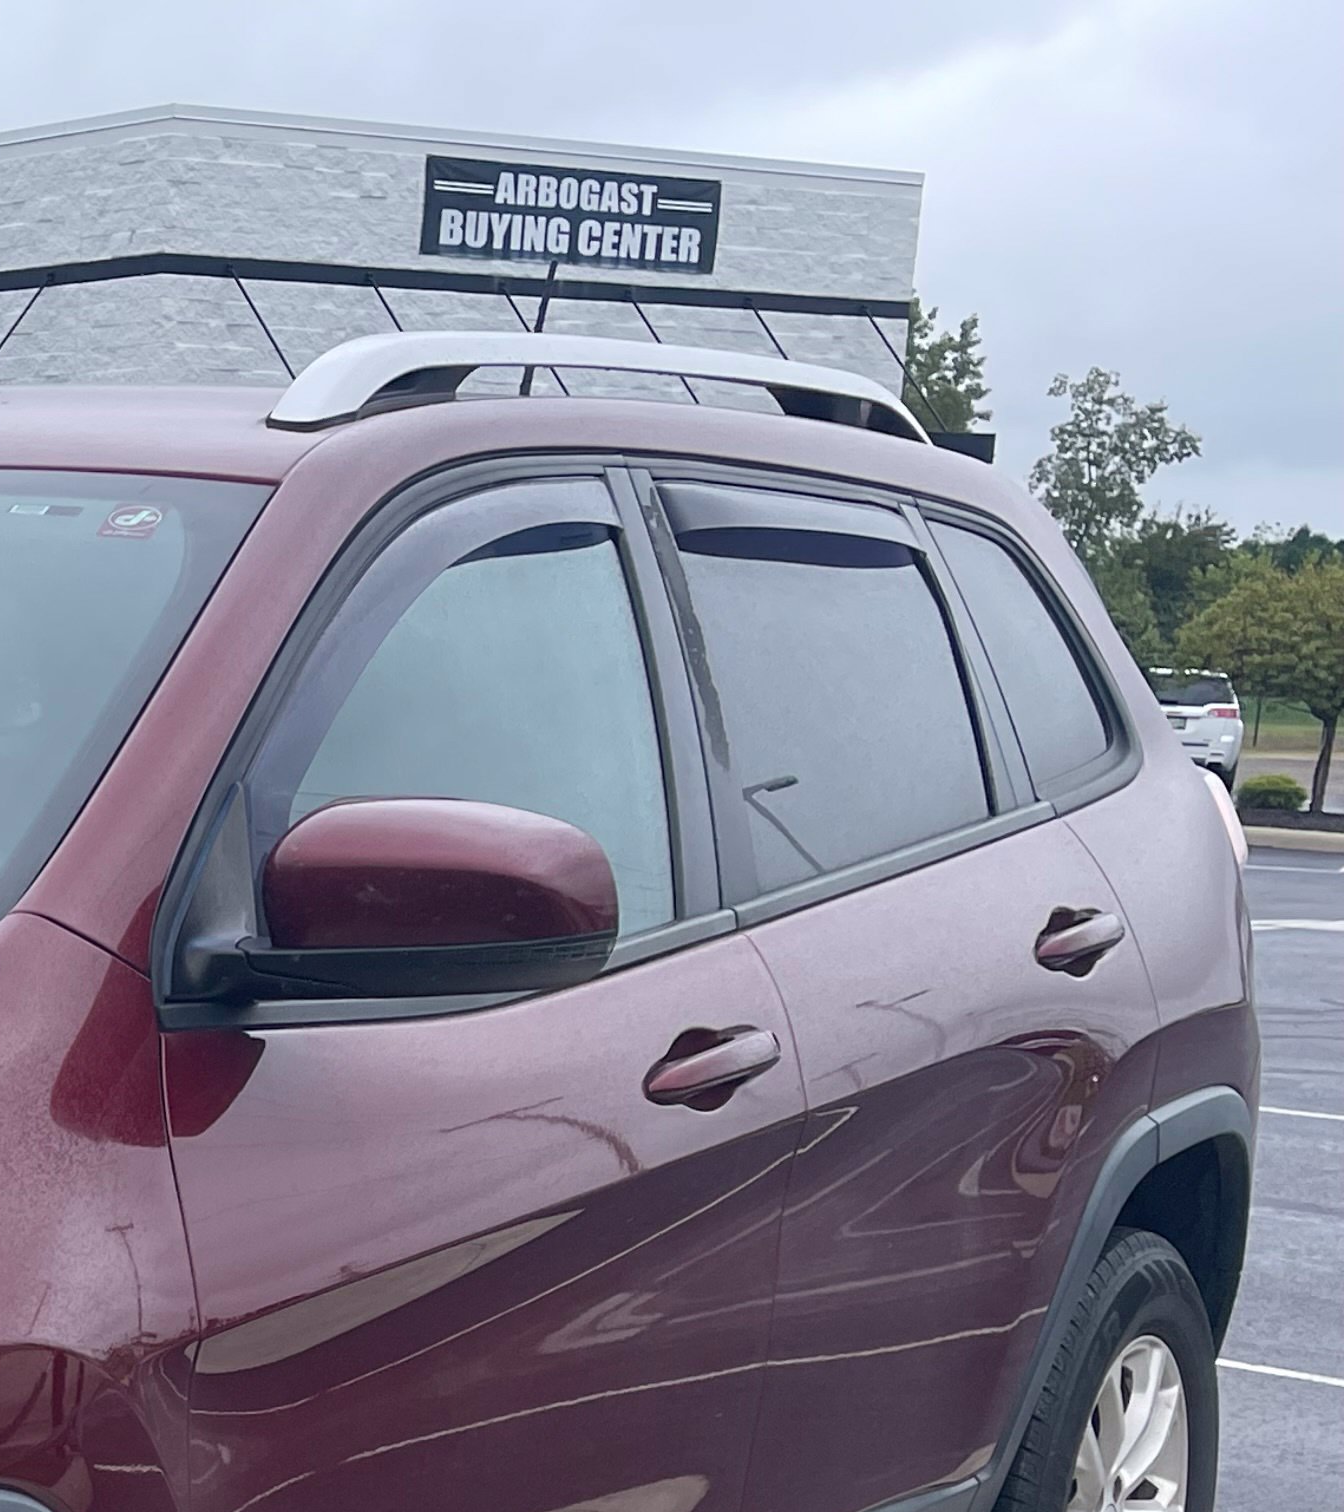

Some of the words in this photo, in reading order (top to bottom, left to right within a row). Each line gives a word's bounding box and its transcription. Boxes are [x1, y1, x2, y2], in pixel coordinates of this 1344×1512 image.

[494, 171, 658, 217] ARBOGAST
[438, 208, 570, 254] BUYING
[577, 219, 702, 264] CENTER
